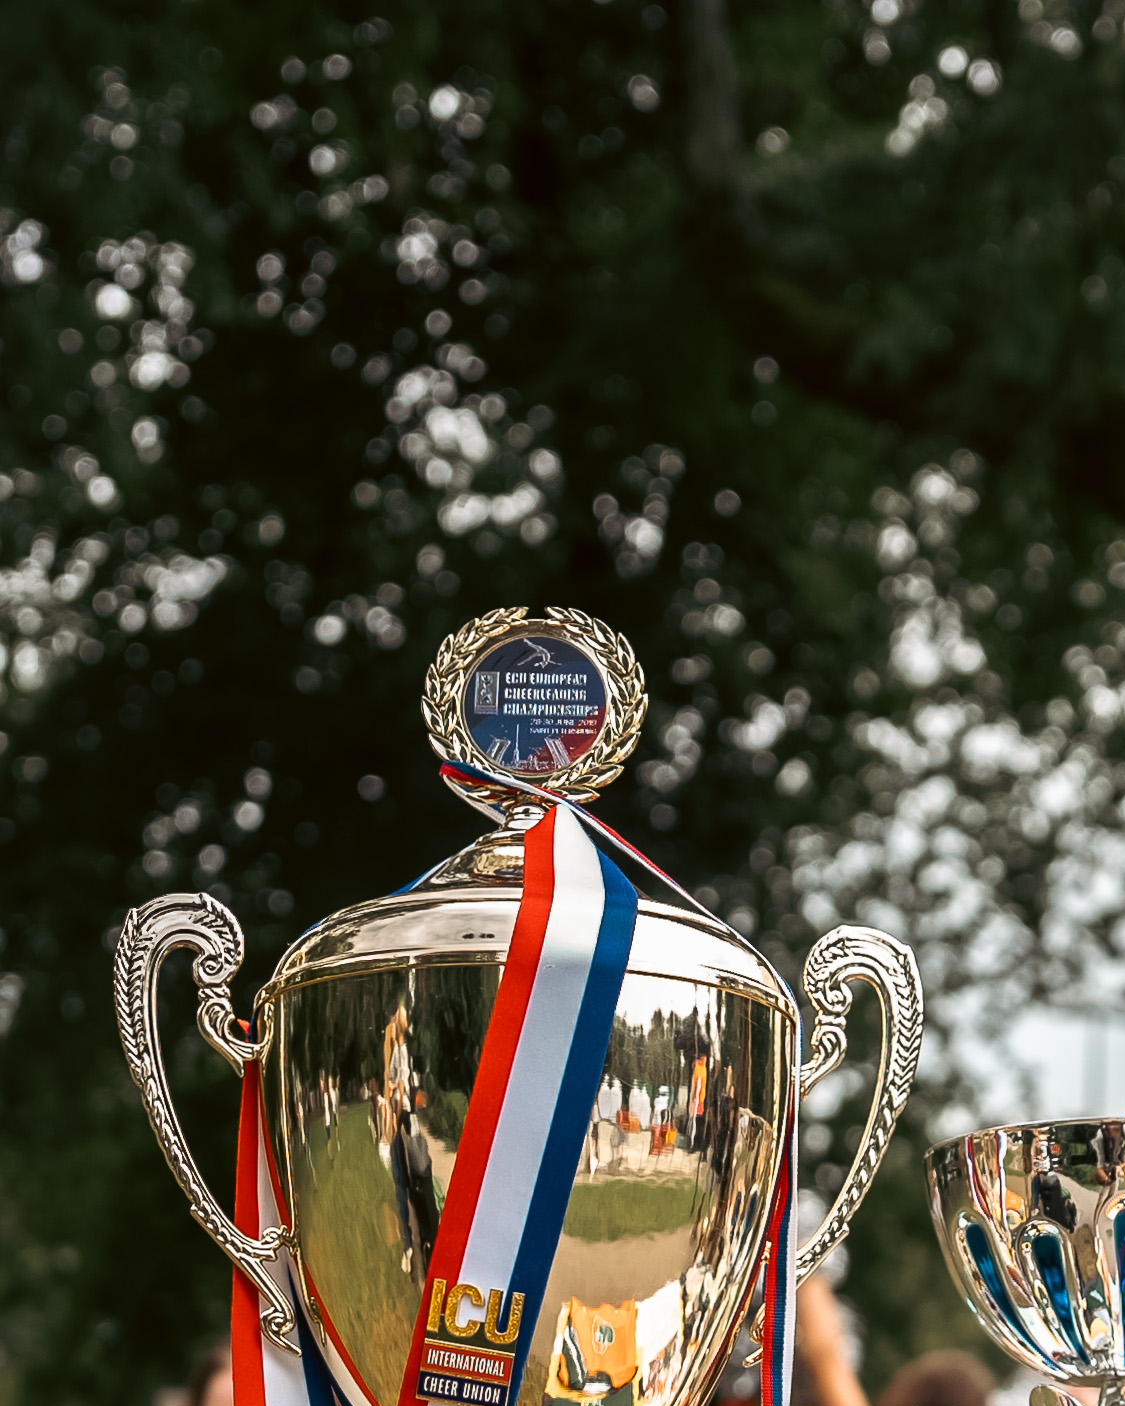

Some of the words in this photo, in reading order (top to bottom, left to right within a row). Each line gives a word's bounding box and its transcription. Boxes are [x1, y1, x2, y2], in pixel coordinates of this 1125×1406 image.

[530, 672, 588, 686] EUROPEAN
[504, 687, 587, 701] CHEERLEADING
[503, 703, 599, 716] CHAMPIONSHIPS
[427, 1278, 526, 1344] ICU
[426, 1348, 505, 1377] INTERNATIONAL
[423, 1376, 459, 1397] CHEER
[462, 1383, 501, 1404] UNION
